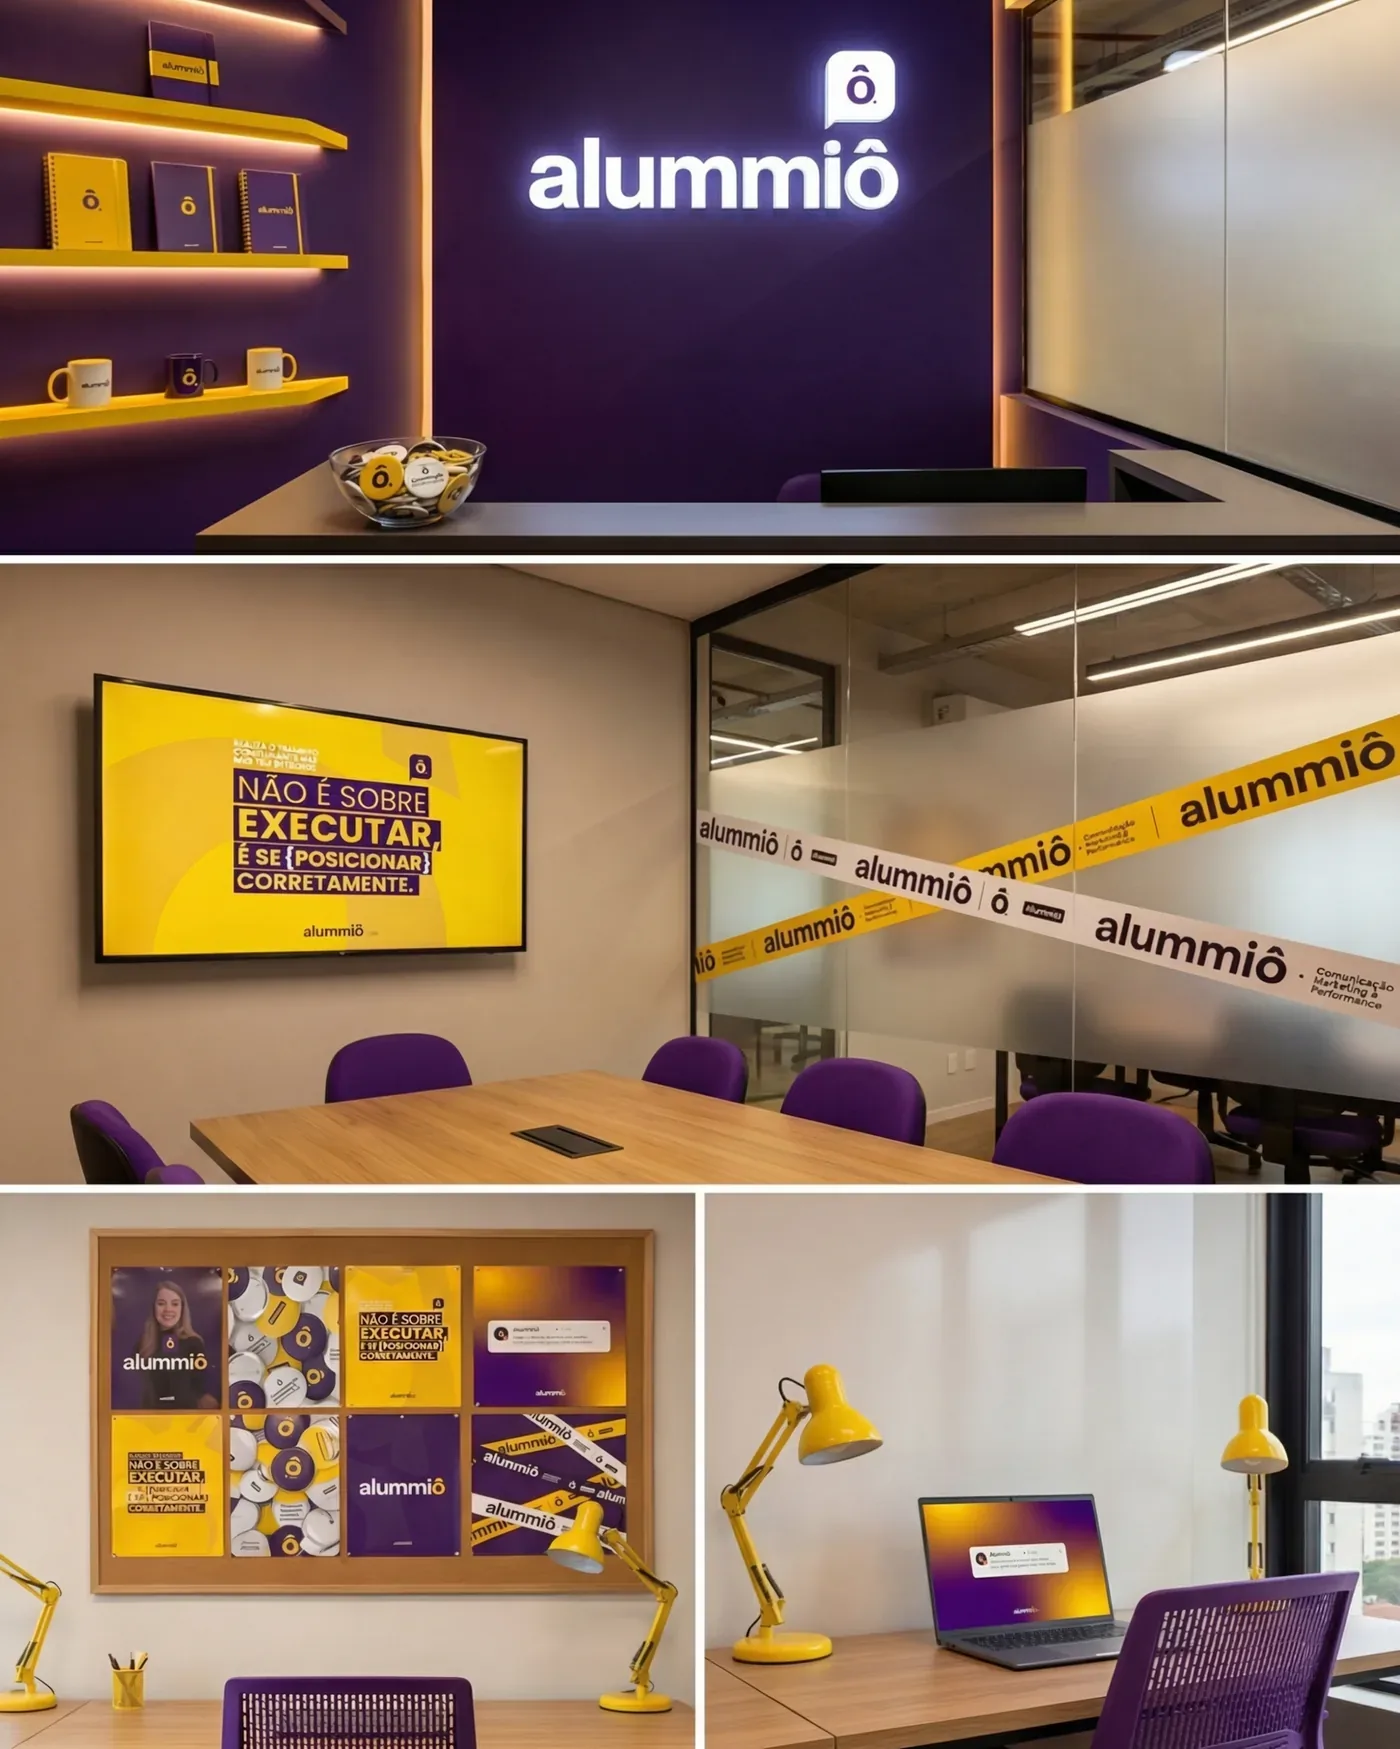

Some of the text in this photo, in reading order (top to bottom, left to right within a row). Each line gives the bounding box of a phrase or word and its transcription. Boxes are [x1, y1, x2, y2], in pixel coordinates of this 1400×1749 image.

[529, 137, 899, 210] alummiô
[238, 774, 426, 814] NÃO É SOBRE
[1179, 731, 1396, 828] alummiô
[238, 808, 440, 852] EXECUTAR,
[238, 843, 250, 865] É
[255, 848, 281, 866] SE
[237, 872, 414, 893] CORRETAMENTE.
[699, 817, 779, 856] alummiô
[855, 855, 972, 905] alummiô
[1095, 912, 1287, 984] alummiô
[763, 905, 855, 954] alummiô
[360, 1313, 388, 1325] NÃO
[401, 1314, 441, 1325] SOBRE
[123, 1353, 208, 1370] alummiô
[359, 1477, 445, 1495] alummiô
[485, 1503, 556, 1531] alummiô
